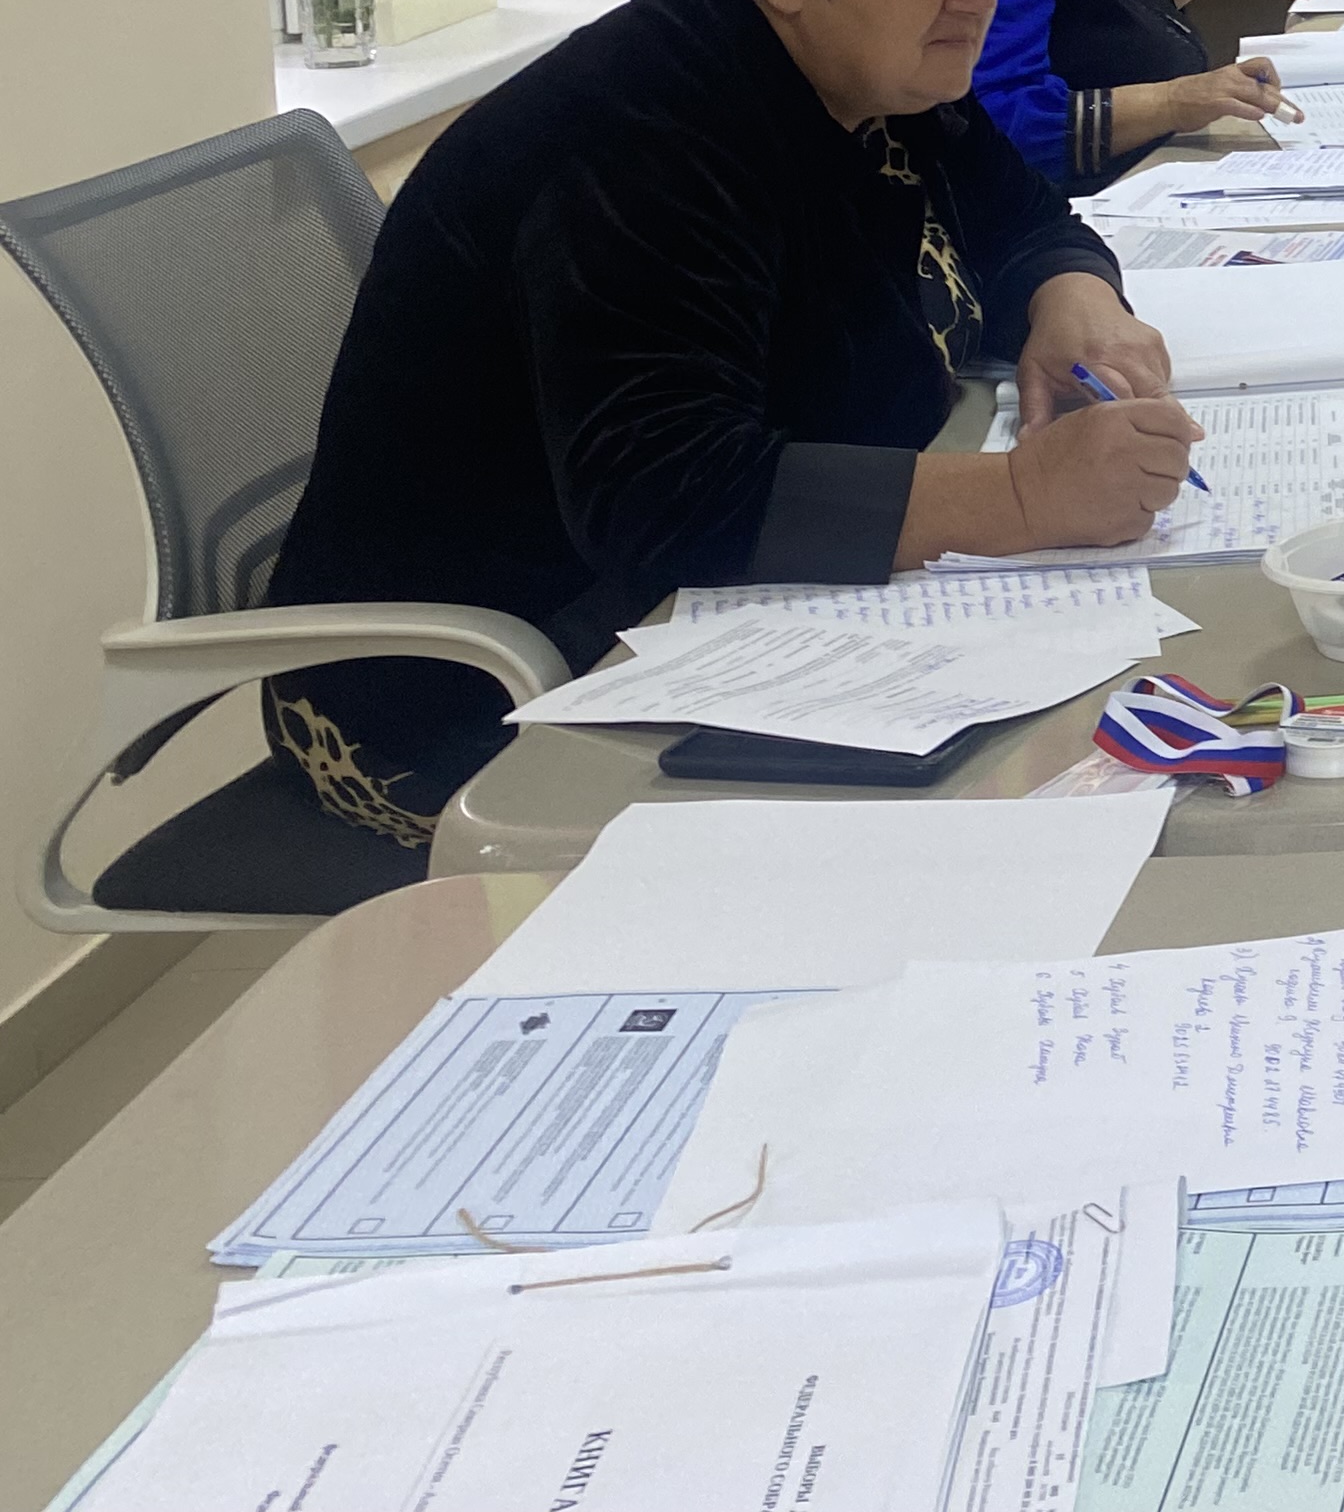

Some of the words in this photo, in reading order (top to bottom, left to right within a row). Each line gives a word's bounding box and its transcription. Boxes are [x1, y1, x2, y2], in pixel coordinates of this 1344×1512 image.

[774, 1374, 820, 1472] ФЕДЕРАЛЬНОГО
[550, 1428, 615, 1512] КНИГА
[795, 1444, 828, 1503] ВЫБОРЫ
